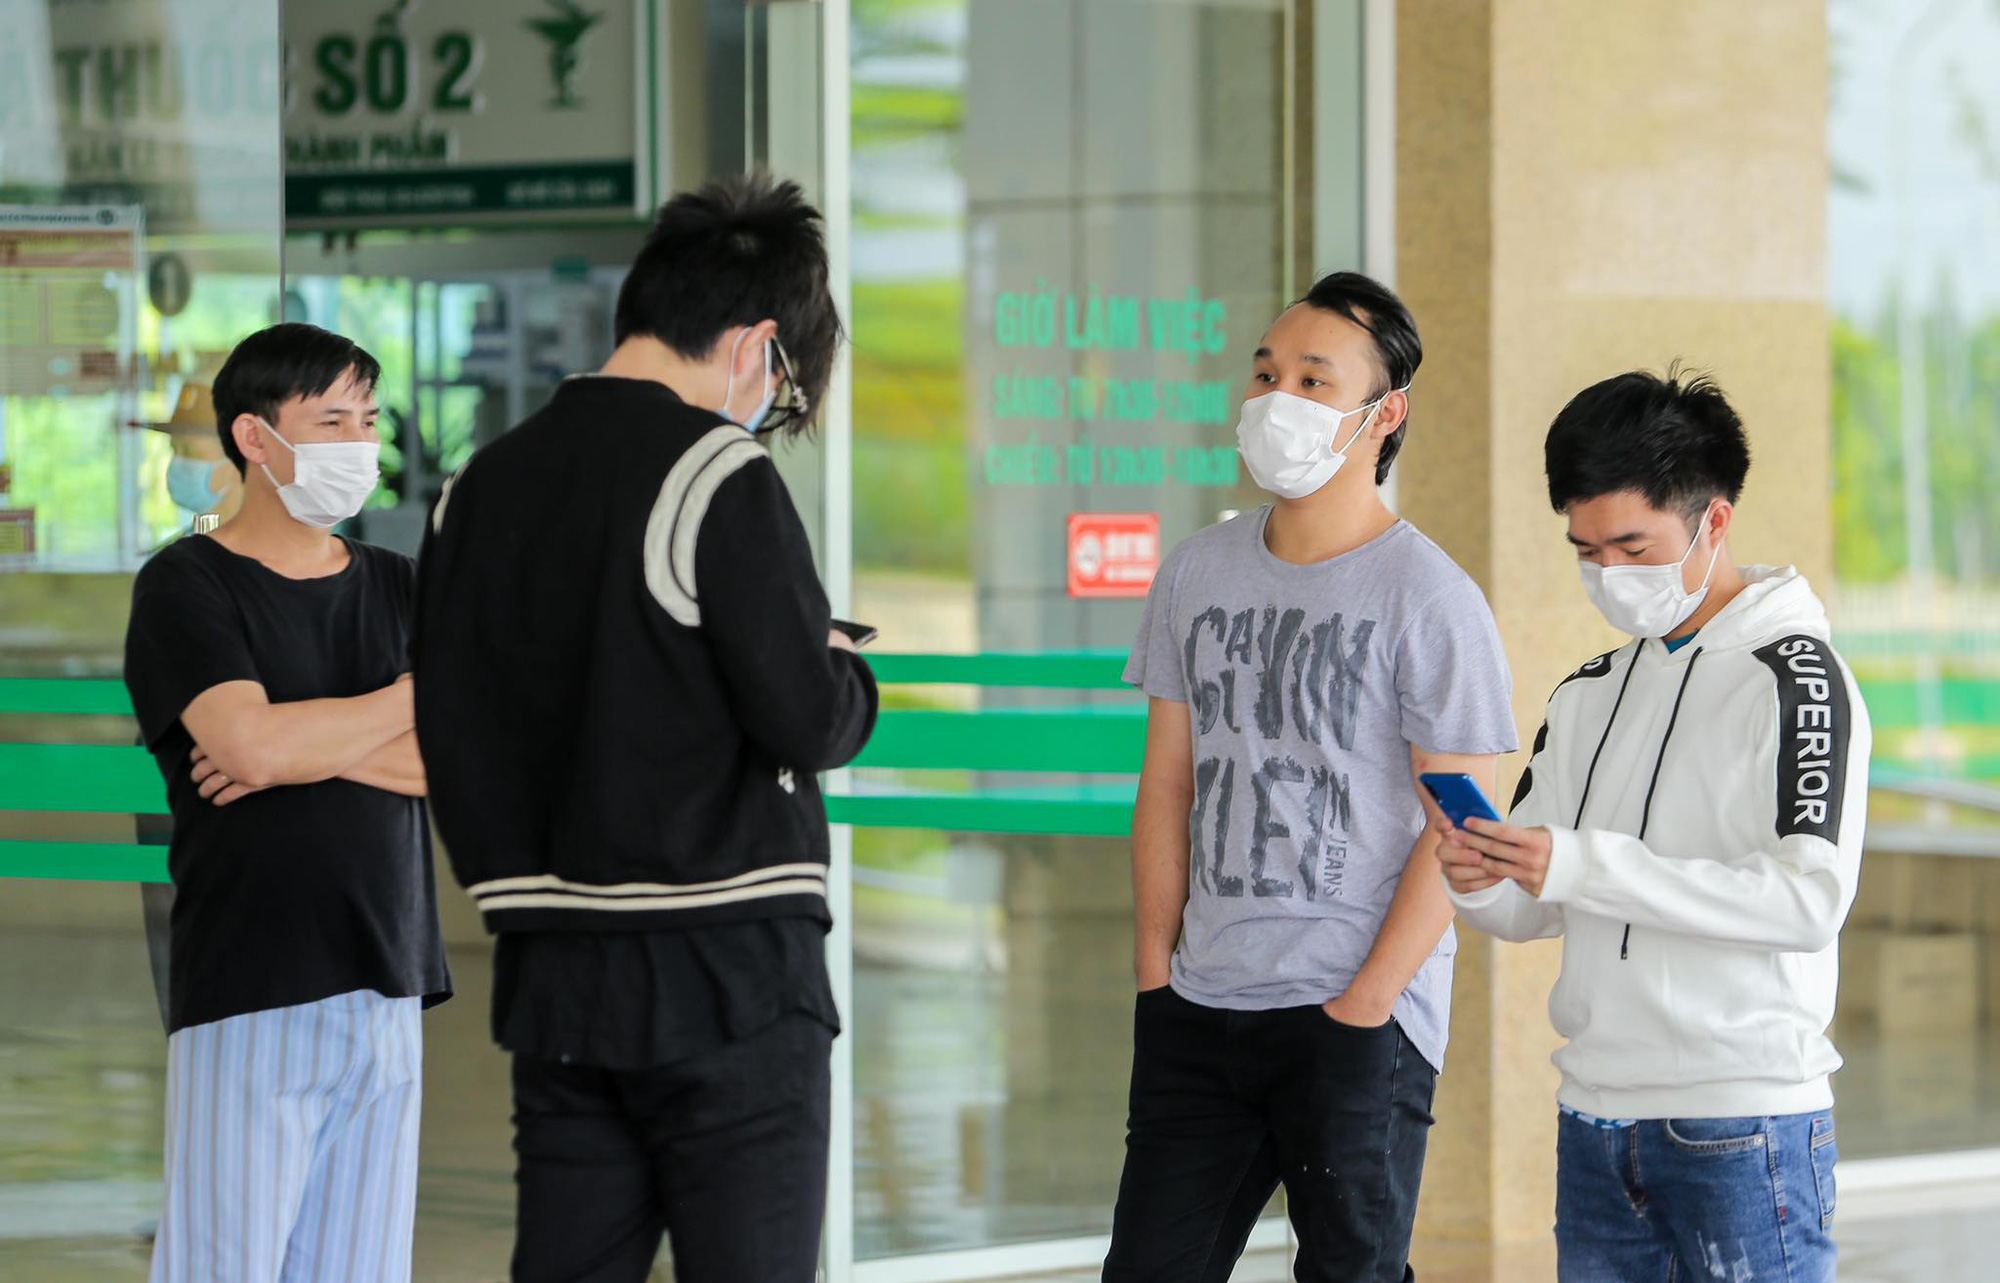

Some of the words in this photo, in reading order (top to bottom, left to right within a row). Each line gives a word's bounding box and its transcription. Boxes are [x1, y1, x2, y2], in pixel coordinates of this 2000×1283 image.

[314, 0, 408, 116] SỐ
[432, 28, 474, 112] 2
[995, 277, 1056, 347] GIỜ
[1064, 283, 1138, 348] LÀM
[1149, 286, 1226, 364] VIỆC
[1777, 639, 1831, 826] SUPERIOR
[1323, 832, 1348, 898] JEANS
